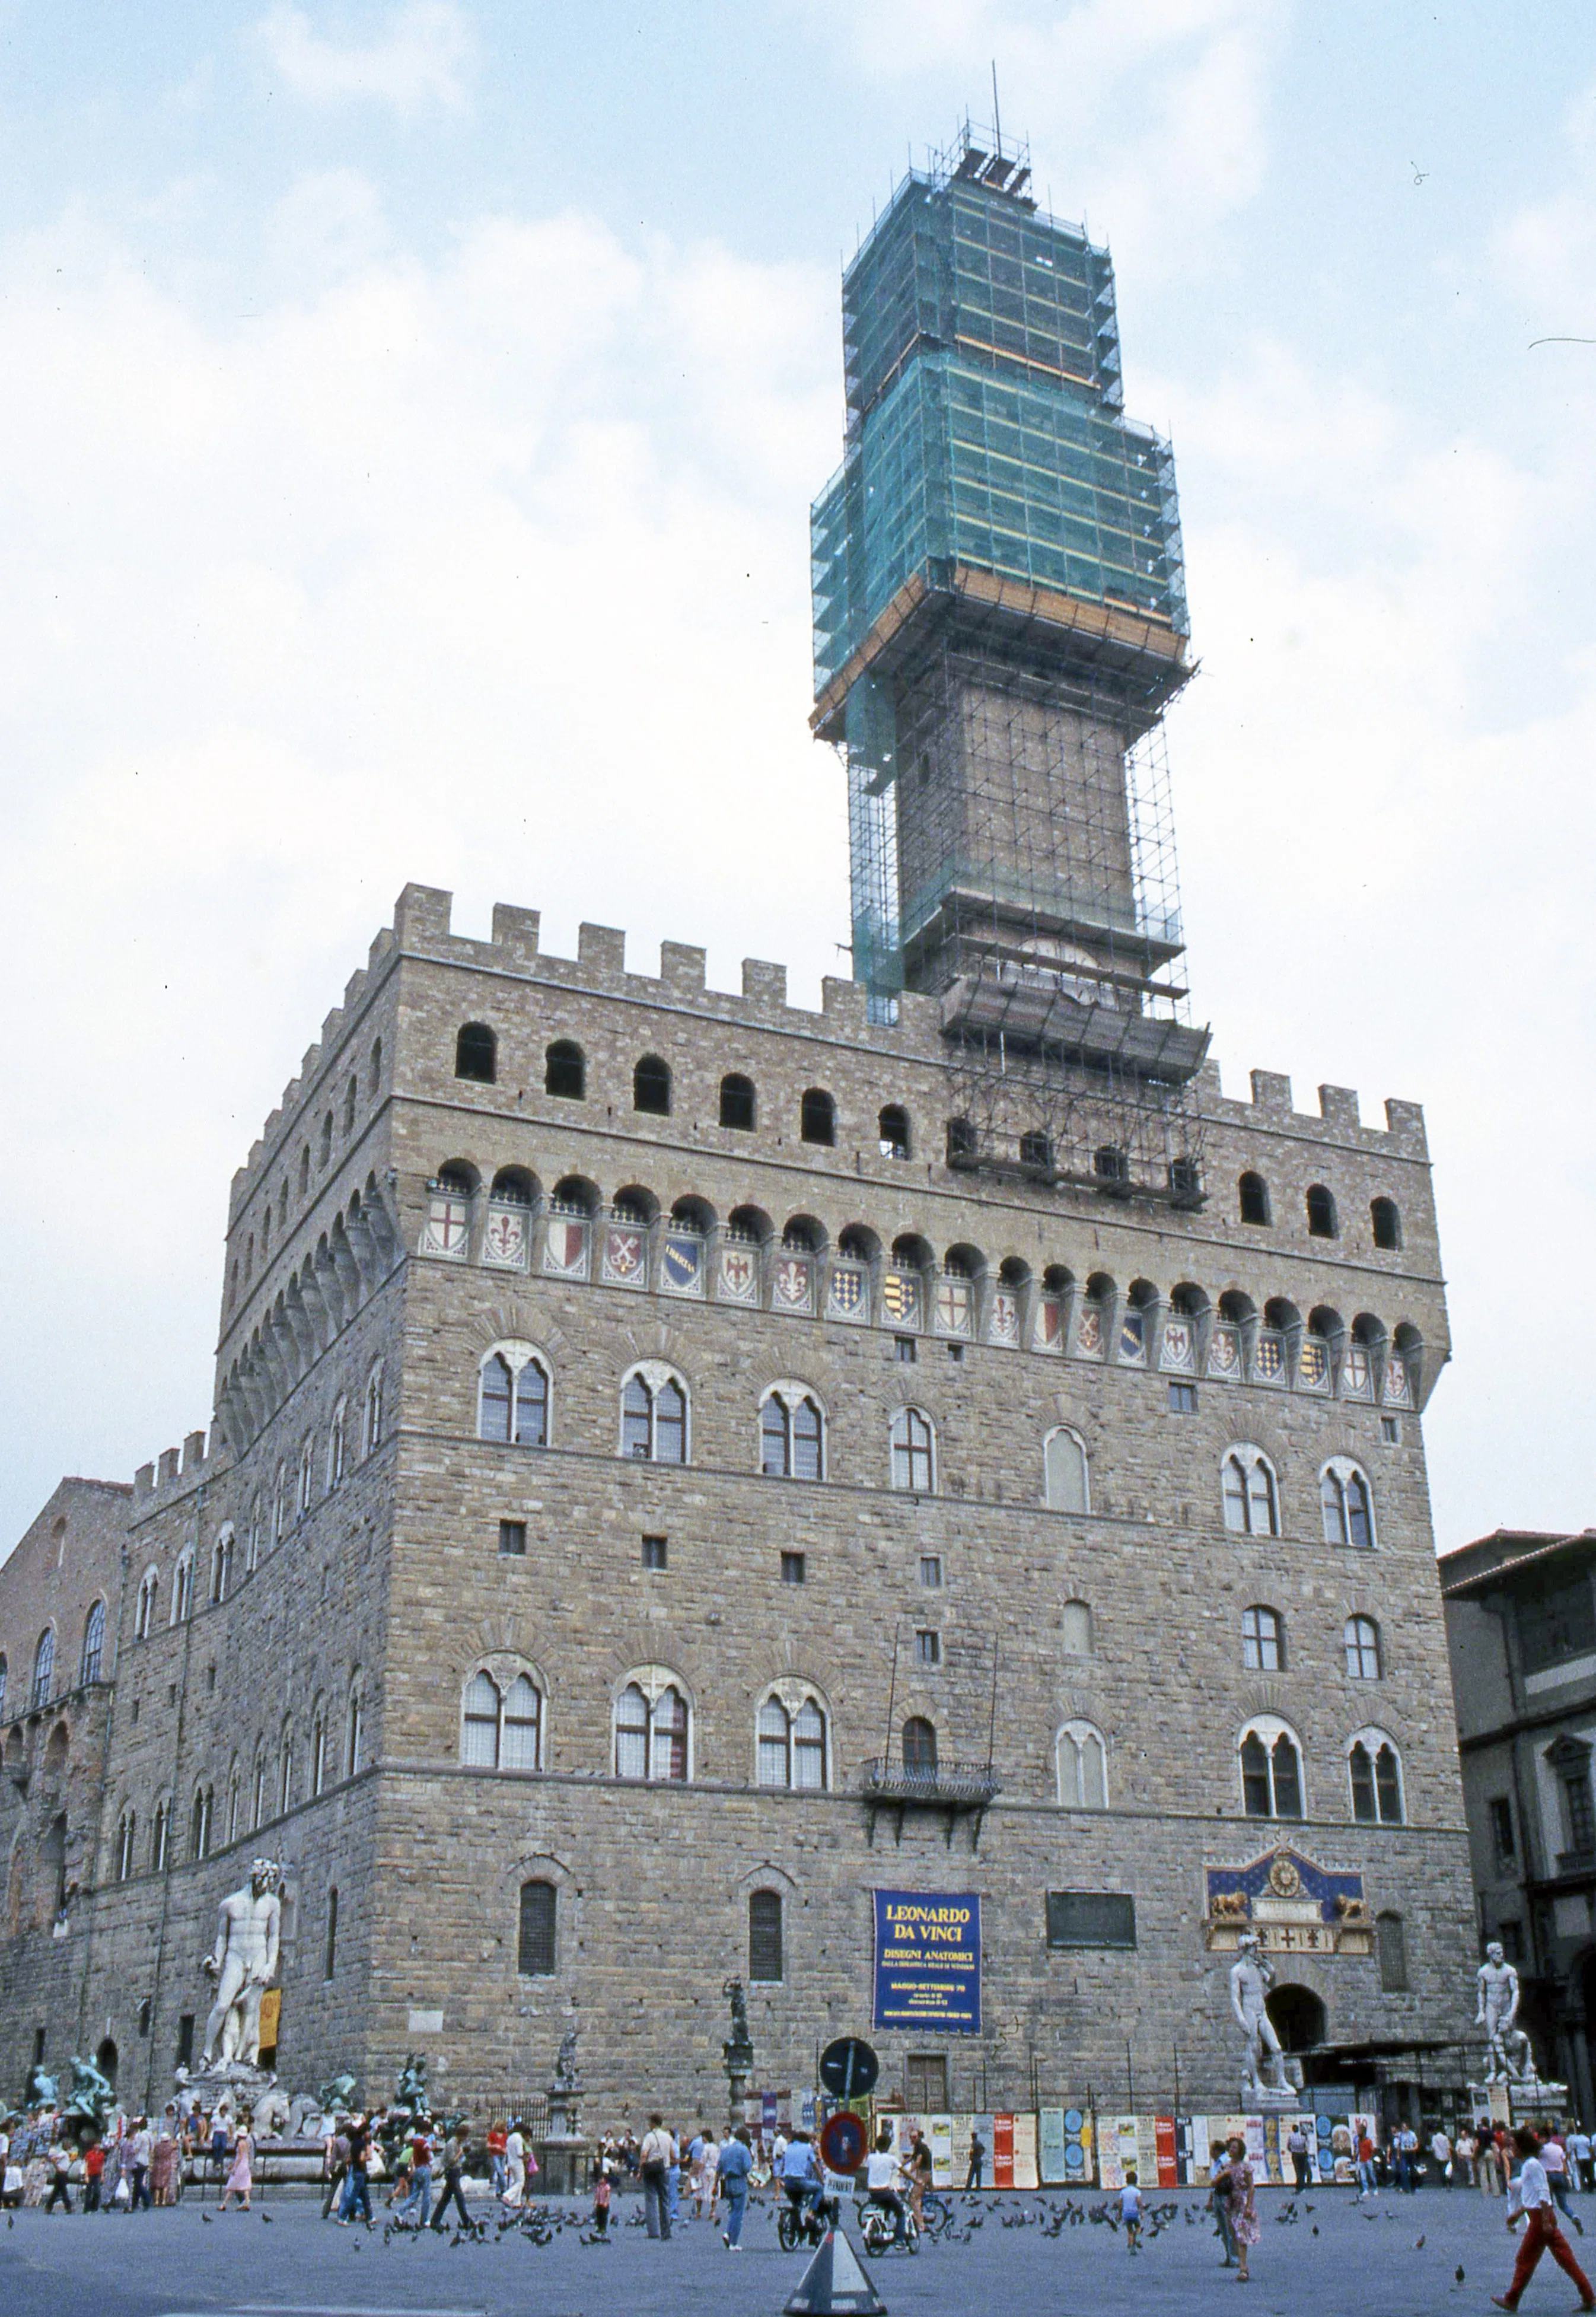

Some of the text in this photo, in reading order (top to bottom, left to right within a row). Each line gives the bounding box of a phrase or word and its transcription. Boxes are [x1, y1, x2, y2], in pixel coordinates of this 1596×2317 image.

[886, 1904, 970, 1923] LEONARDO
[894, 1924, 961, 1942] DA VINCI
[884, 1948, 973, 1962] DISEGNI ANATOMICI
